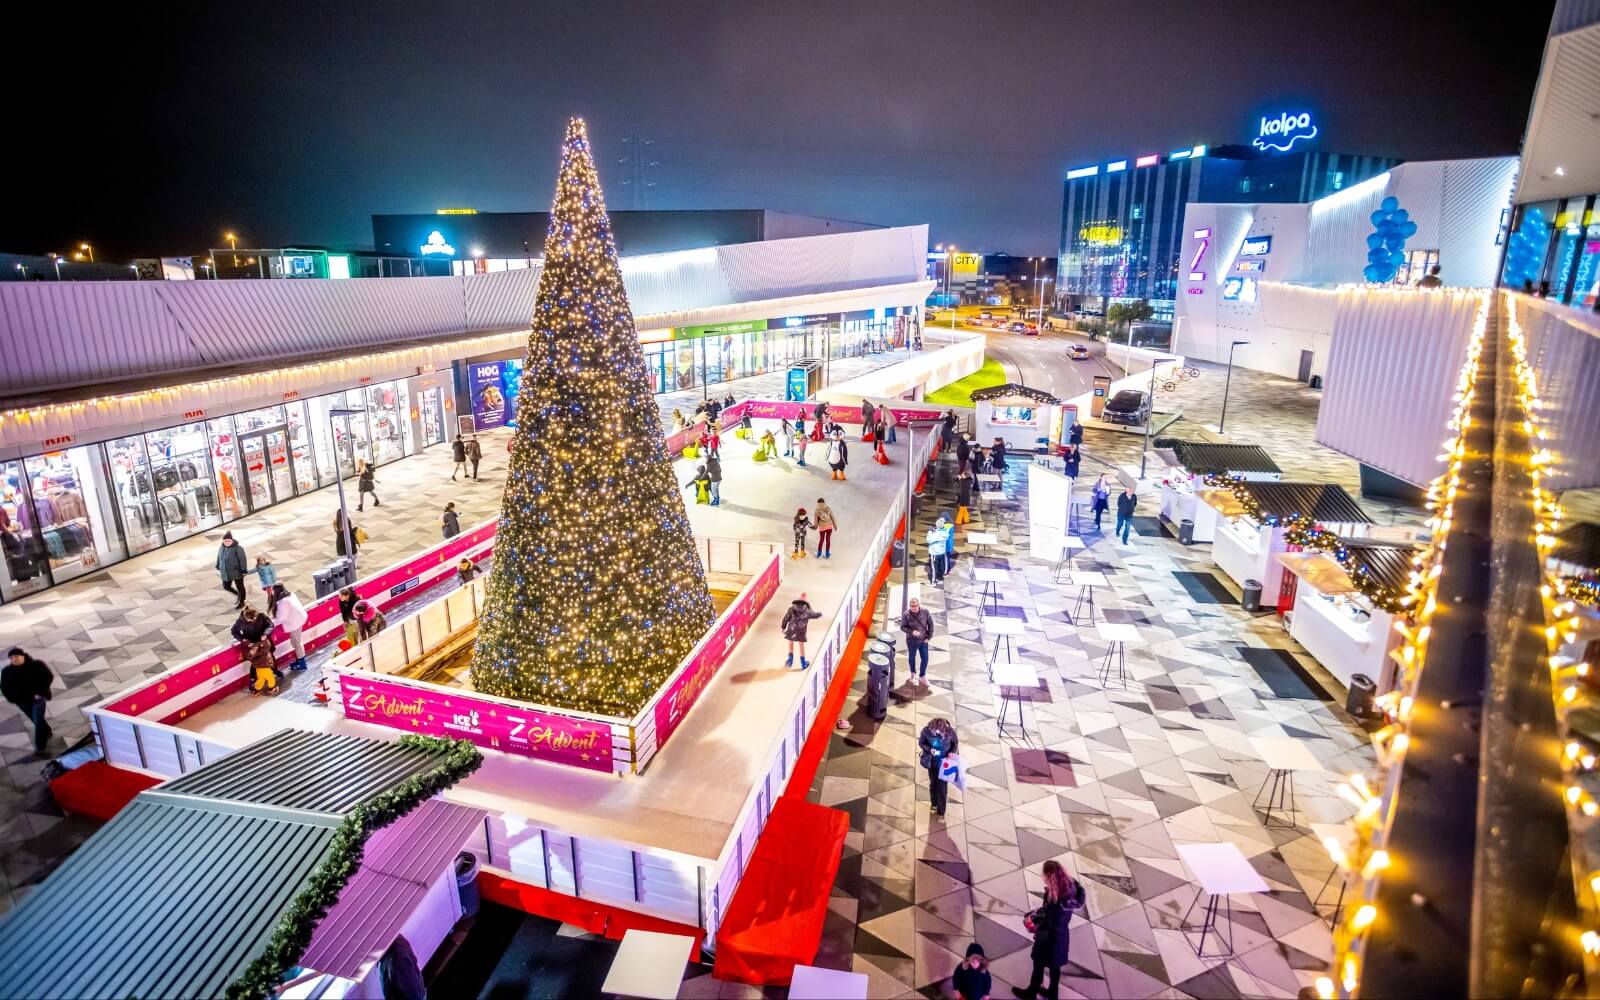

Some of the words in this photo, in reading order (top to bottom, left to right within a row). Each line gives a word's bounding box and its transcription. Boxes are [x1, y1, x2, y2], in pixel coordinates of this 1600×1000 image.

[1260, 112, 1310, 136] kolpa
[955, 256, 977, 265] CITY
[477, 365, 500, 378] HOG
[247, 452, 264, 462] ULAZ
[364, 693, 426, 717] Advent
[453, 714, 471, 727] ICE
[527, 726, 600, 752] Advent
